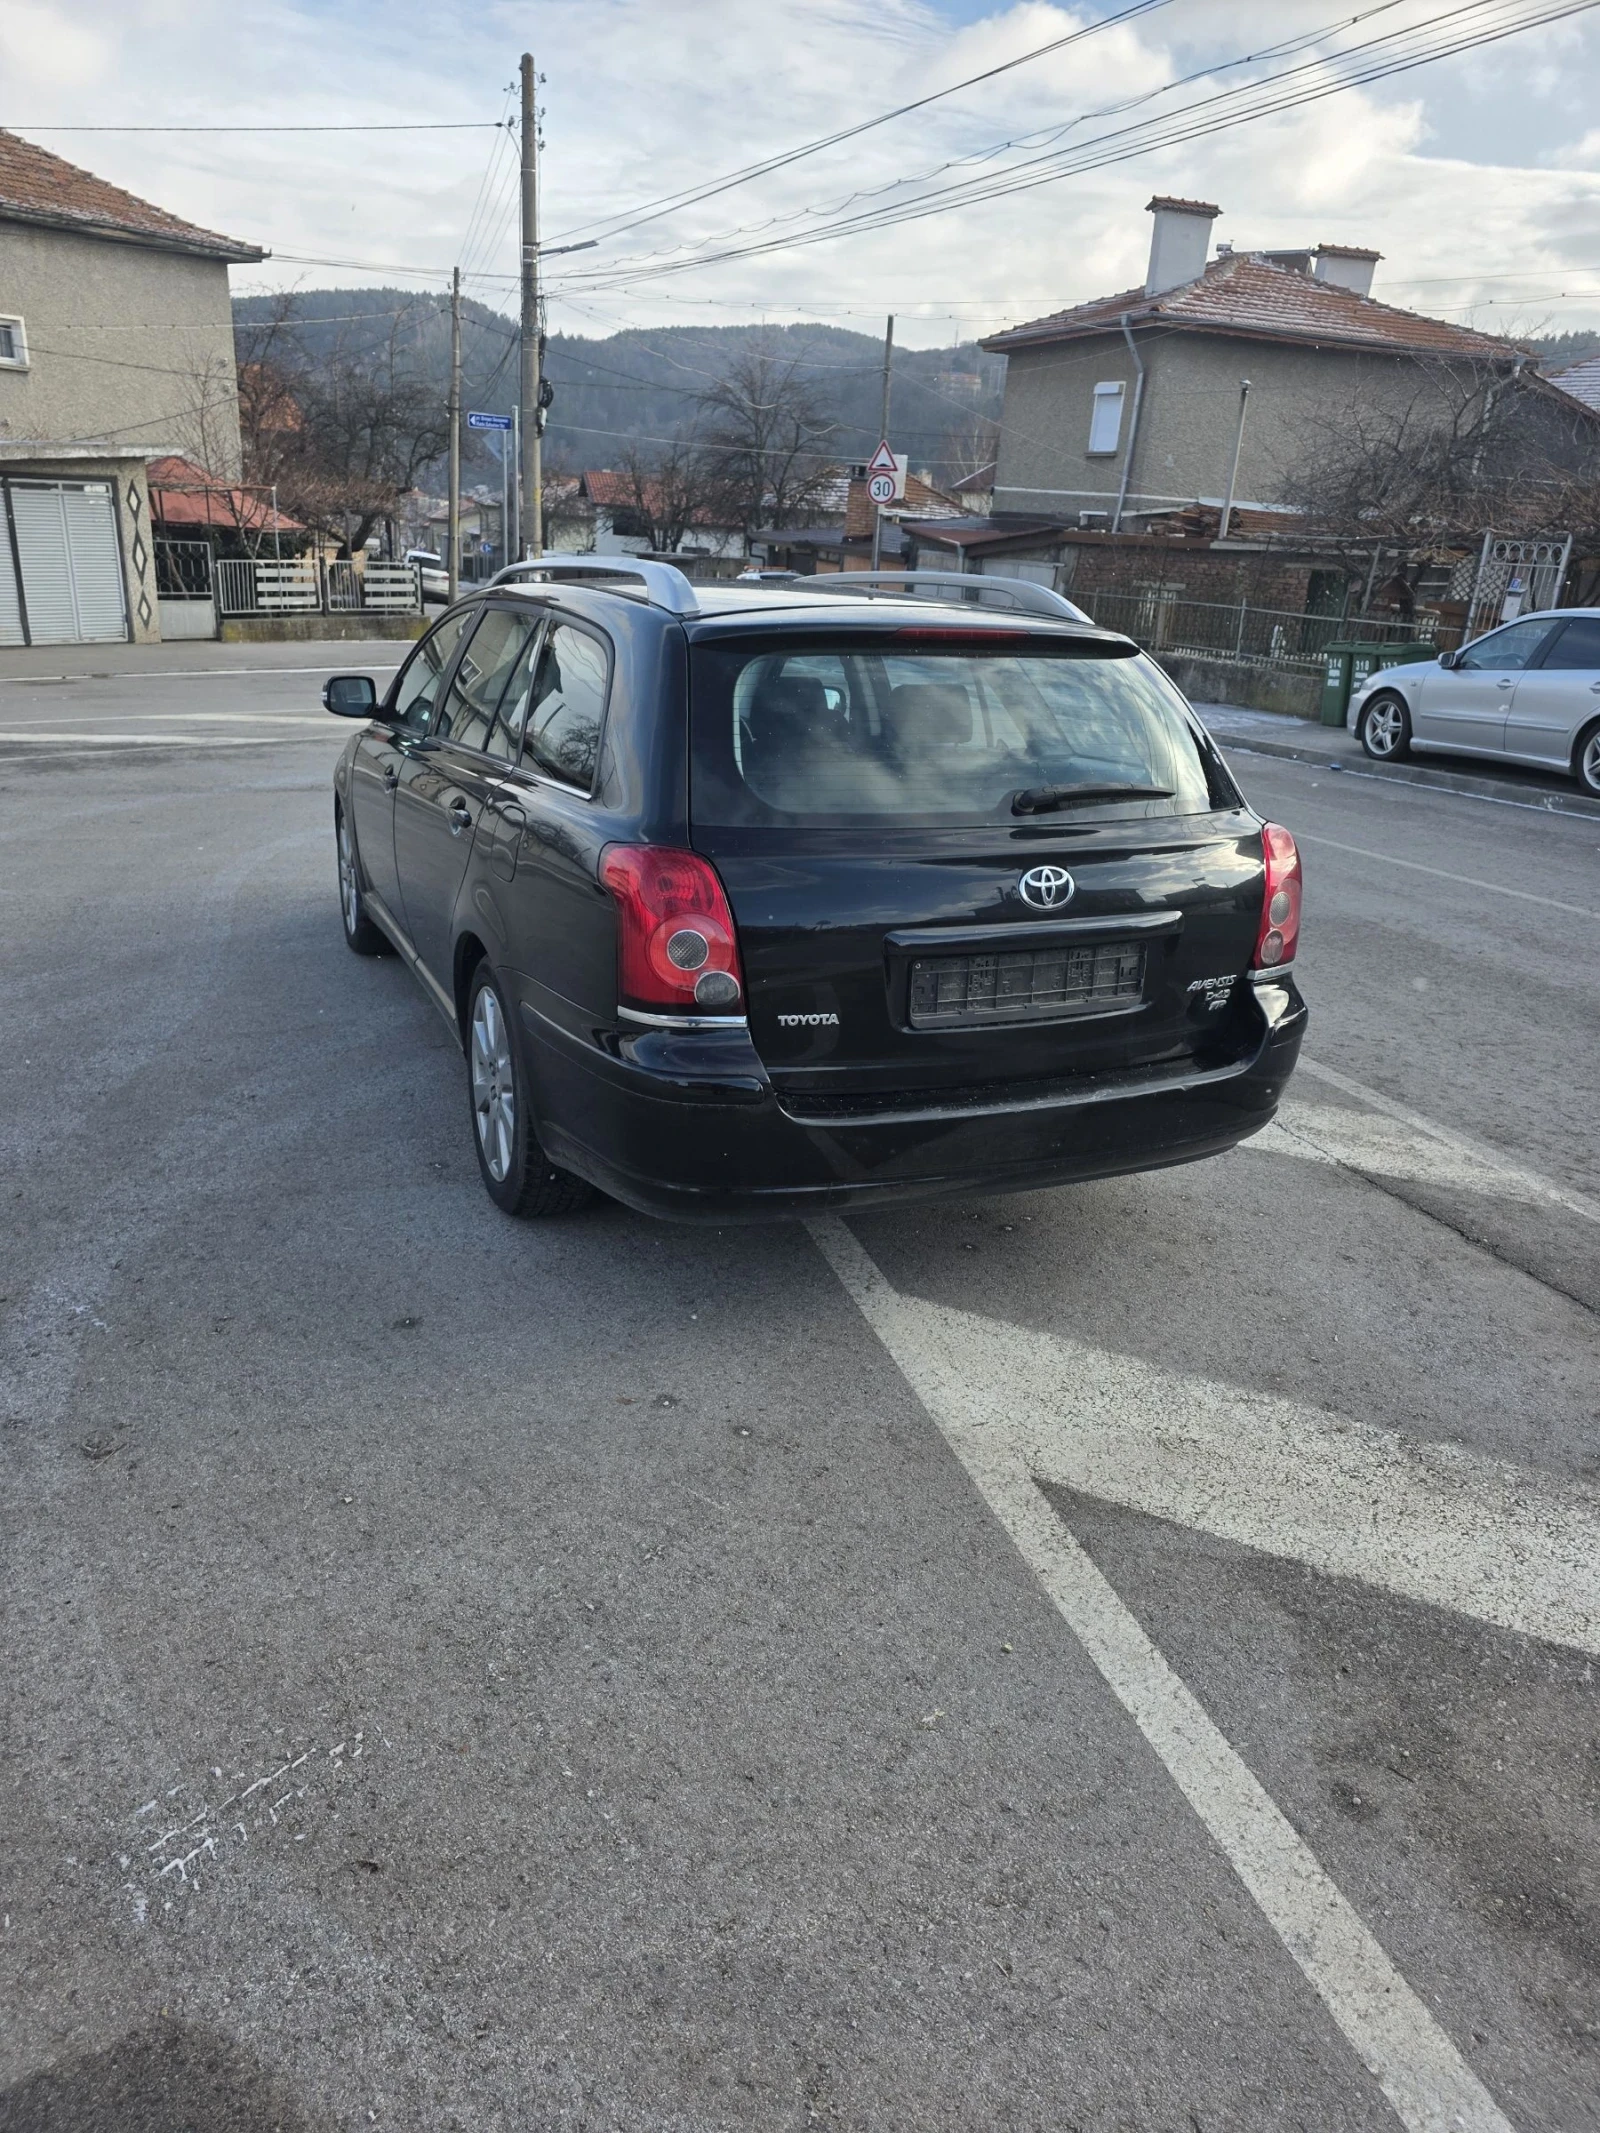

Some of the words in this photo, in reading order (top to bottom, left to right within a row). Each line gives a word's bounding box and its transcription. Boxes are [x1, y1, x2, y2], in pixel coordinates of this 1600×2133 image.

[873, 481, 891, 497] 30
[1328, 658, 1342, 669] 314
[1186, 974, 1237, 992] AVENSIS
[777, 1013, 840, 1027] TOYOTA
